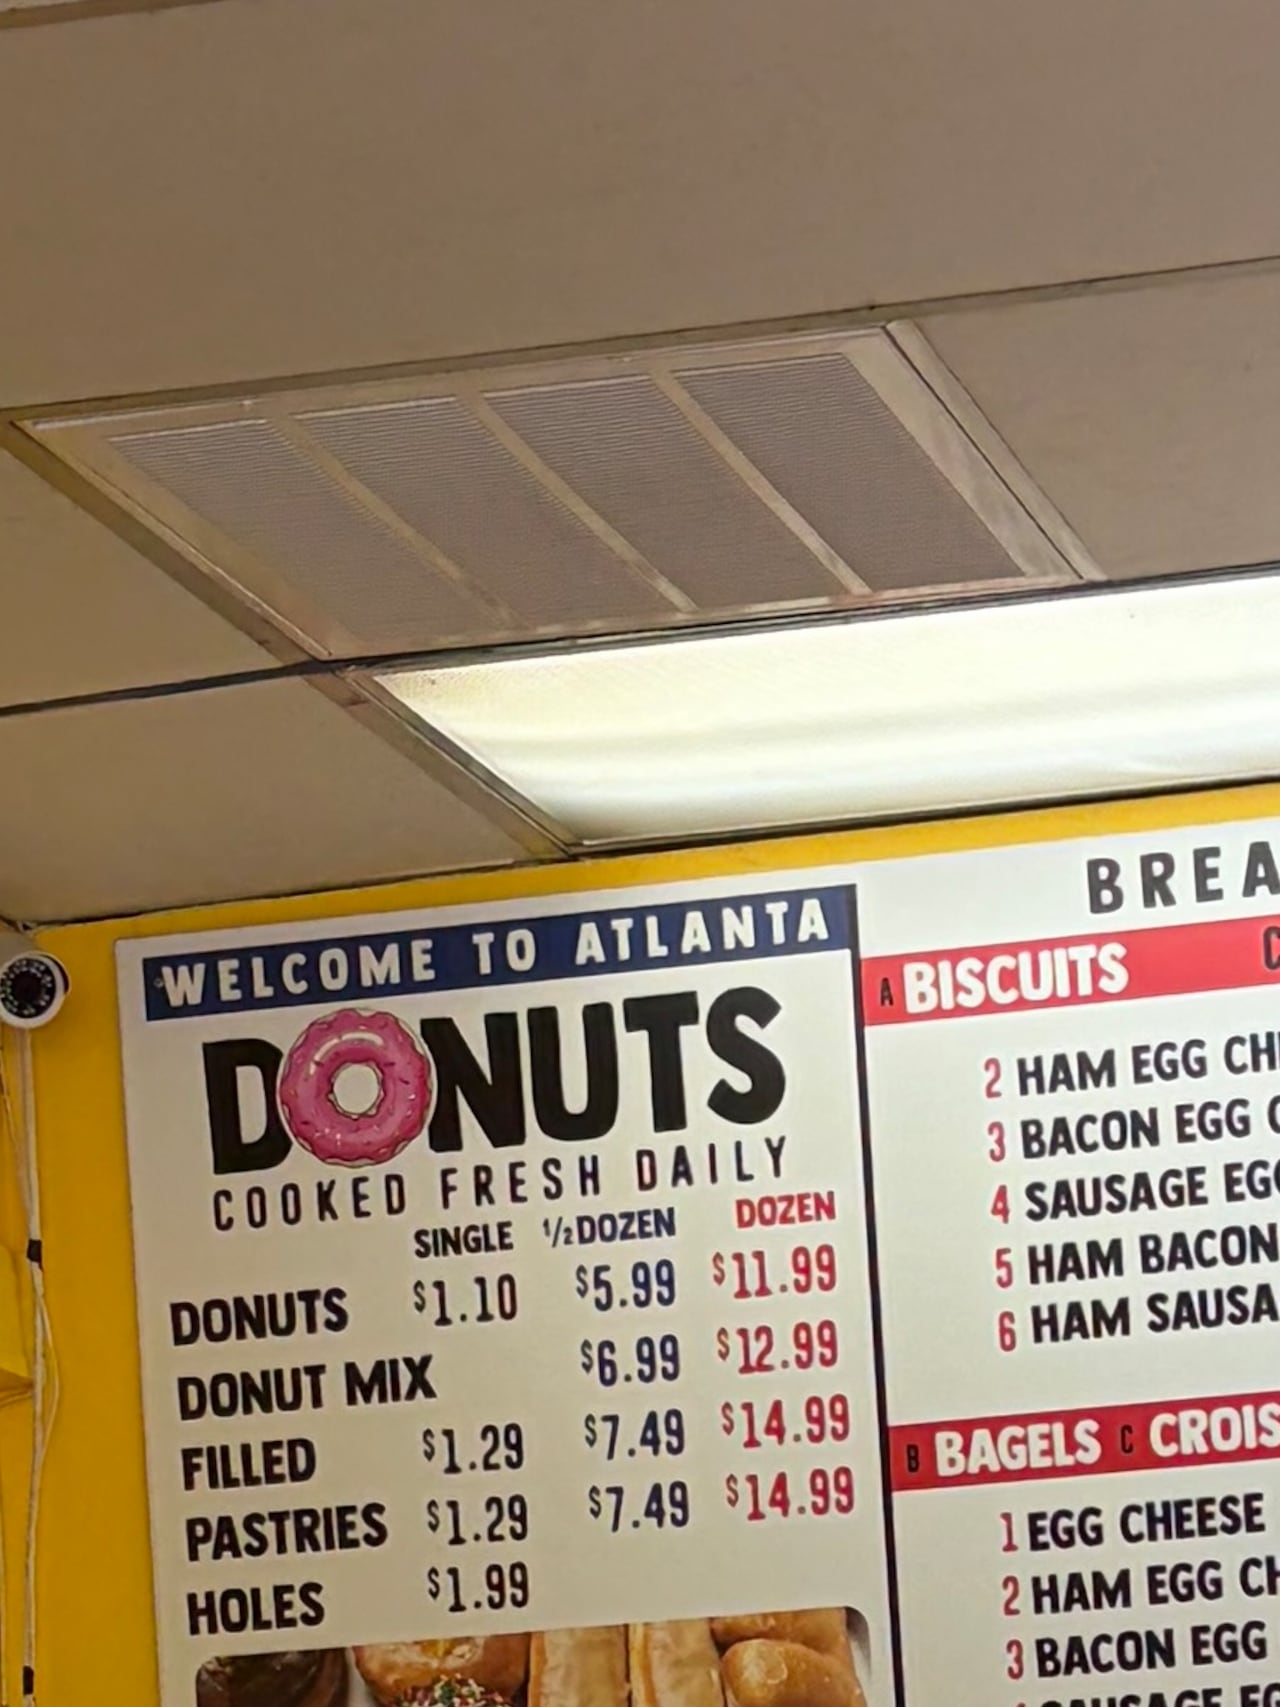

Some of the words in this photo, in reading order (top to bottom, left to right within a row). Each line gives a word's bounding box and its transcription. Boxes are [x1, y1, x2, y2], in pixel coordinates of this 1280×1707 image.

[162, 939, 435, 1006] WELCOME
[472, 929, 535, 974] TO
[576, 898, 828, 964] ATLANTA
[904, 943, 1128, 1013] BISCUITS
[1017, 1049, 1116, 1096] HAM
[1132, 1039, 1207, 1084] EGG
[1021, 1108, 1159, 1159] BACON
[1175, 1099, 1250, 1143] EGG
[214, 1174, 405, 1231] COOKED
[441, 1155, 600, 1210] FRESH
[636, 1136, 785, 1191] DAILY
[1025, 1166, 1208, 1221] SAUSAGE
[414, 1221, 513, 1258] SINGLE
[736, 1191, 835, 1228] DOZEN
[1028, 1238, 1123, 1284] HAM
[1139, 1223, 1279, 1274] BACON
[170, 1288, 348, 1346] DONUTS
[413, 1274, 517, 1326] $1.10
[576, 1259, 675, 1311] $5.99
[712, 1244, 836, 1299] $11.99
[1031, 1297, 1130, 1343] HAM
[178, 1364, 326, 1420] DONUT
[345, 1355, 437, 1406] MIX
[581, 1335, 680, 1386] $6.99
[717, 1320, 837, 1374] $12.99
[181, 1438, 316, 1491] FILLED
[423, 1423, 523, 1474] $1.29
[585, 1409, 684, 1460] $7.49
[722, 1394, 849, 1448] $14.99
[935, 1419, 1101, 1476] BAGELS
[186, 1503, 387, 1562] PASTRIES
[427, 1494, 527, 1545] $1.29
[589, 1481, 689, 1532] $7.49
[726, 1467, 854, 1521] $14.99
[1028, 1507, 1103, 1551] EGG
[1120, 1493, 1265, 1543] CHEESE
[187, 1582, 324, 1635] HOLES
[428, 1562, 529, 1612] $1.99
[1032, 1569, 1131, 1614] HAM
[1147, 1561, 1223, 1605] EGG
[1035, 1629, 1175, 1677] BACON
[1191, 1621, 1267, 1665] EGG
